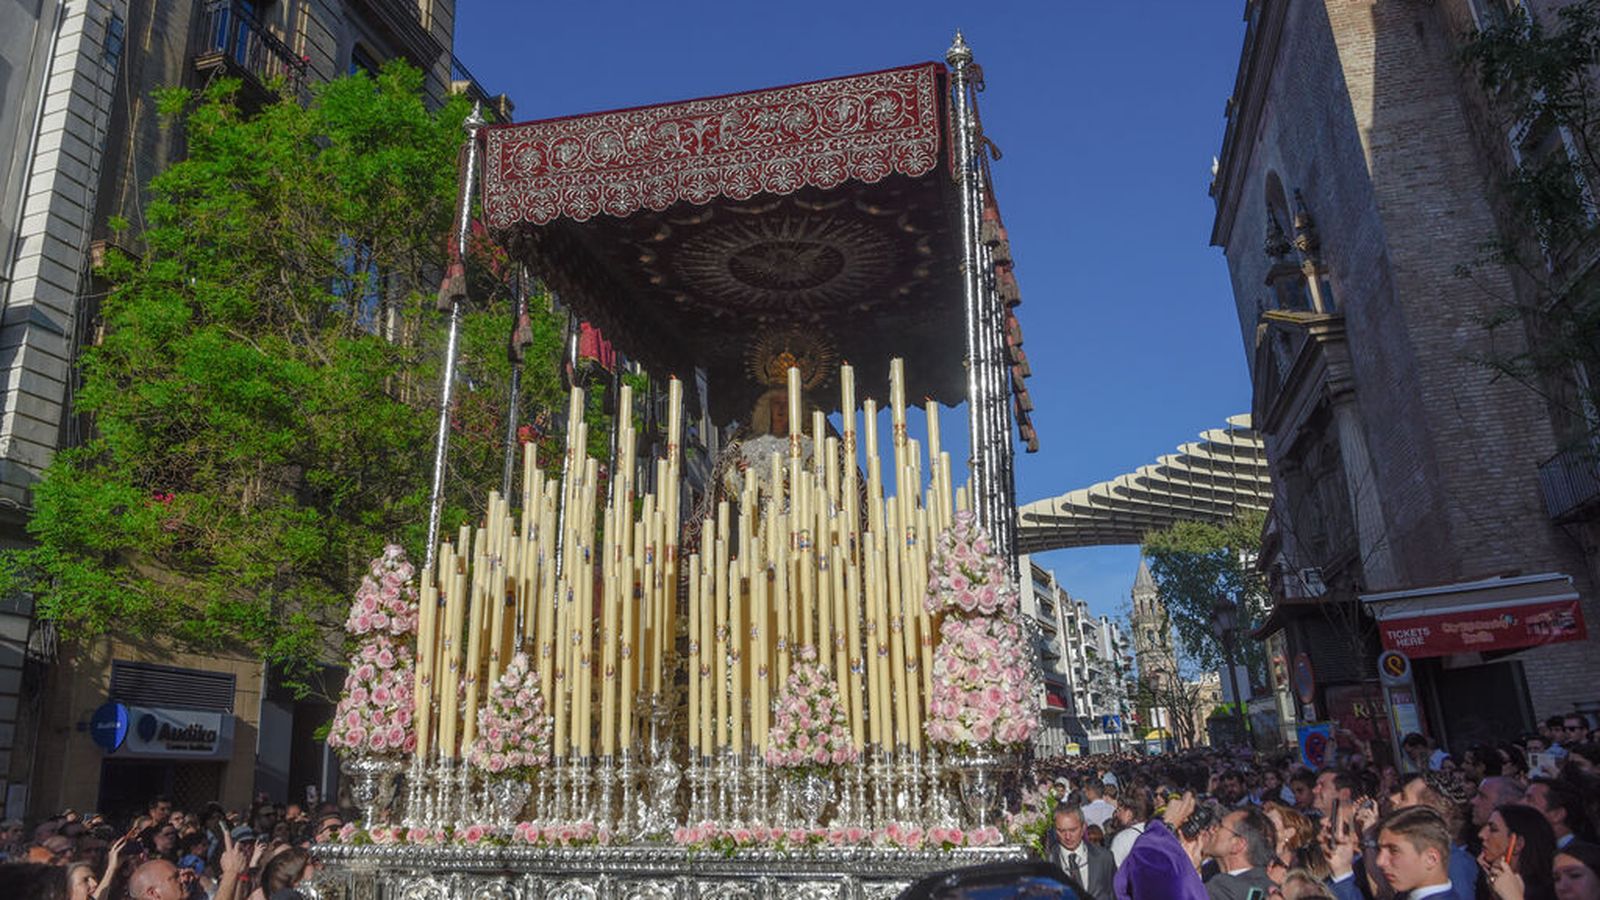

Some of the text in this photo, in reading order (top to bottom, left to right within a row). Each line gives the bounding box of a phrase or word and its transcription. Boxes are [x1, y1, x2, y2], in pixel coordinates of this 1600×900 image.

[1387, 627, 1430, 640] TICKETS
[1396, 637, 1425, 648] HERE
[157, 722, 216, 742] Audika
